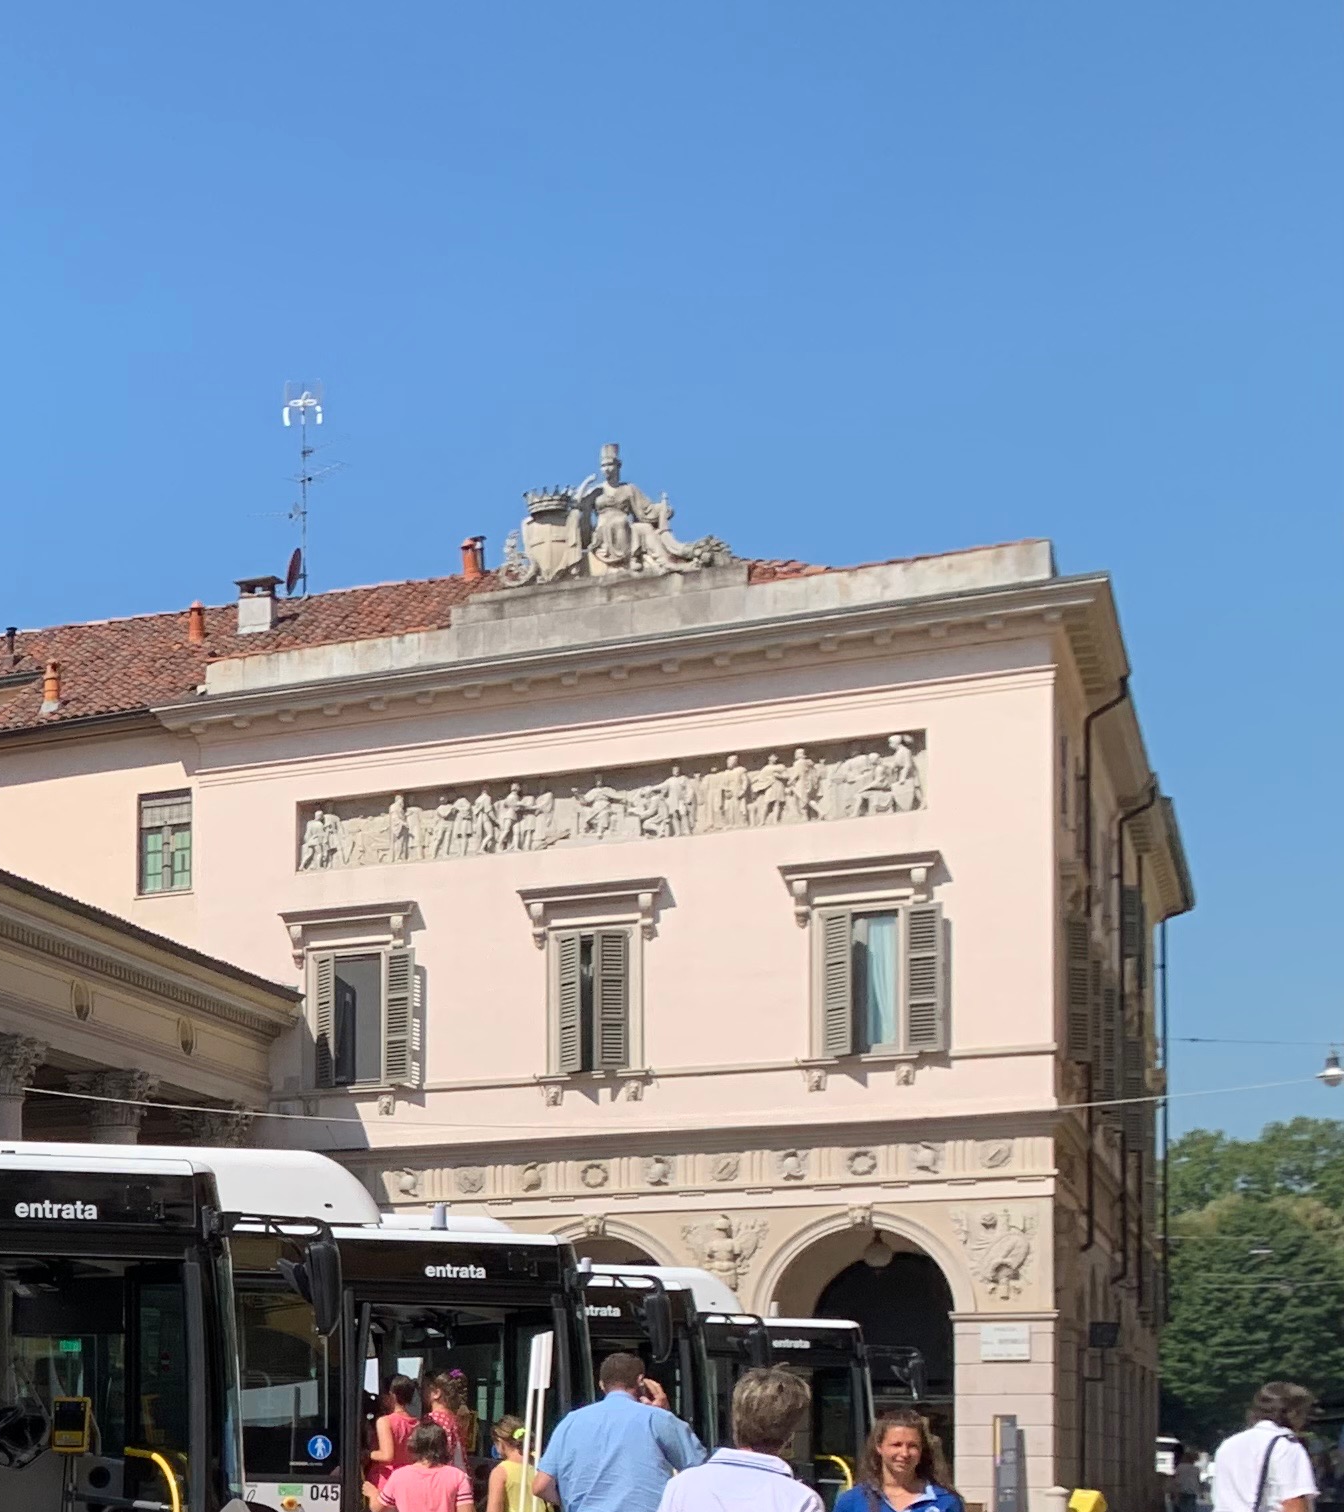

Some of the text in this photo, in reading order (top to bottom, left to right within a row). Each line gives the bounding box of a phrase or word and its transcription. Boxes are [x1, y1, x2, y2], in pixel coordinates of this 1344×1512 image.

[14, 1200, 98, 1220] entrata
[424, 1263, 487, 1279] entrata
[772, 1338, 811, 1349] entrata
[310, 1485, 339, 1501] 045
